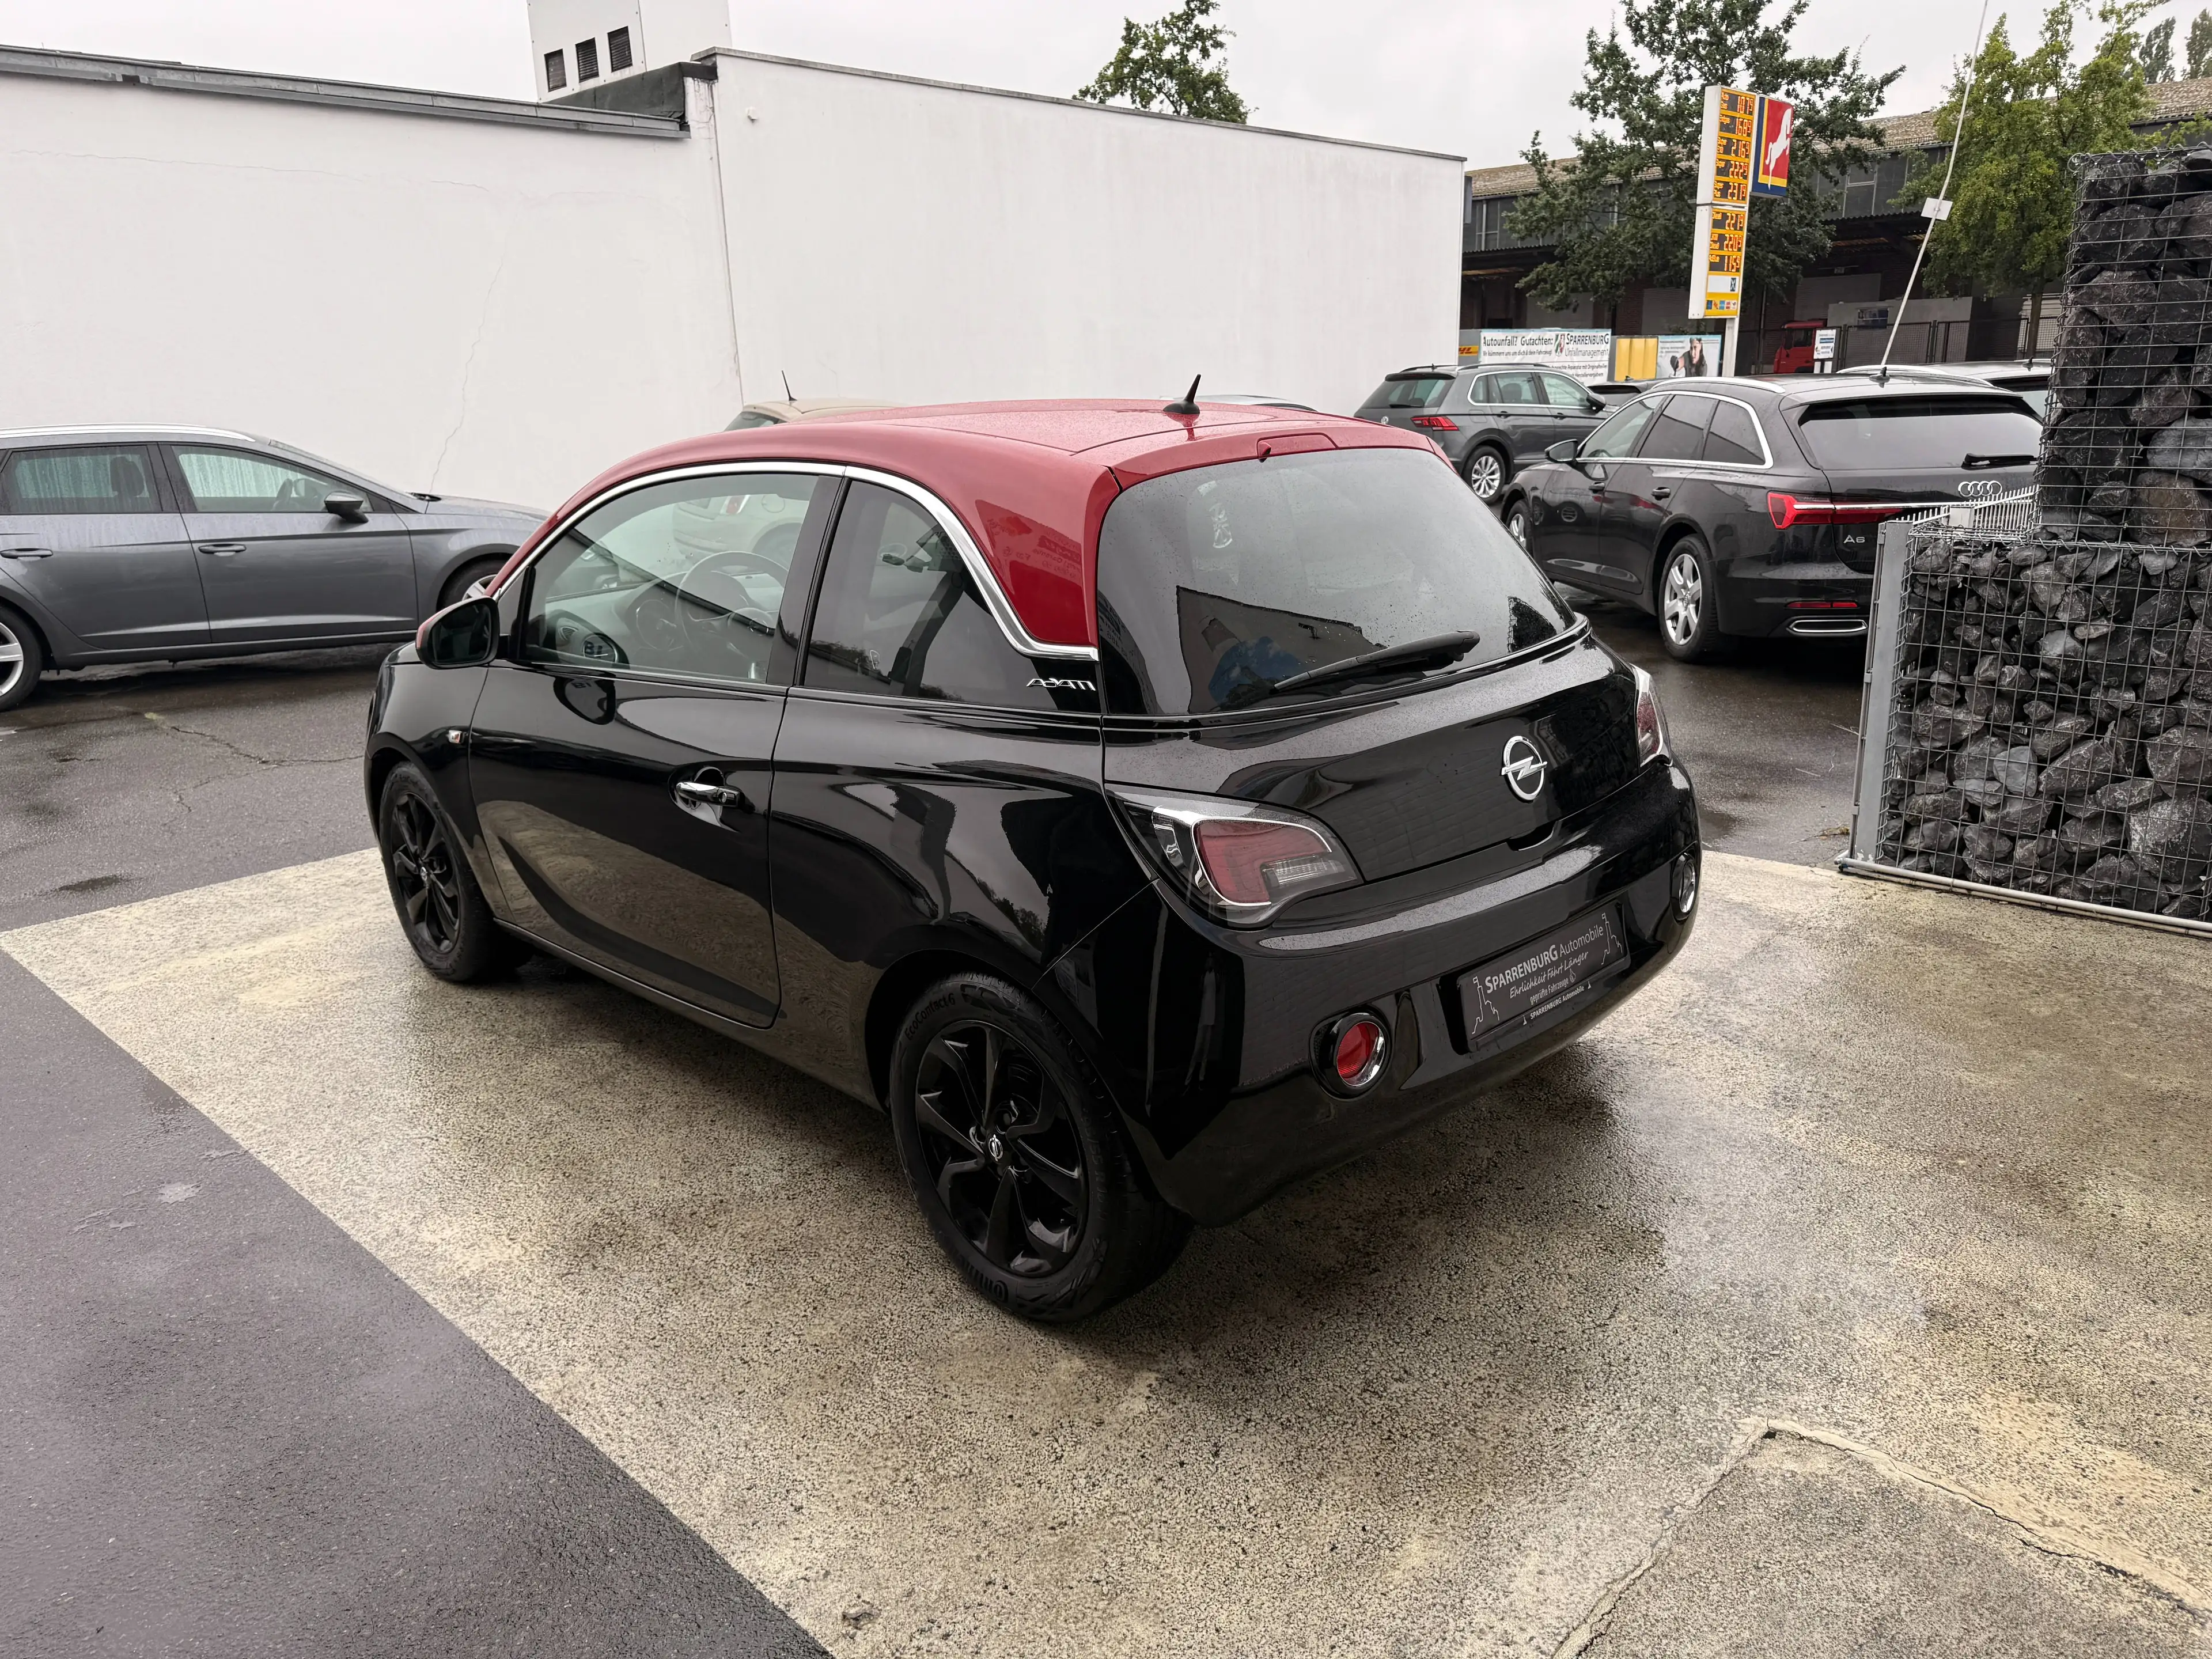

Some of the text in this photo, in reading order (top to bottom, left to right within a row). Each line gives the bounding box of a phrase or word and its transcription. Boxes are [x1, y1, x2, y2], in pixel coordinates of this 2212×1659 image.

[1483, 335, 1554, 346] Autounfall? Gutachten:
[1566, 333, 1609, 345] SPARRENBURG
[1565, 348, 1609, 358] Unfallmanagement
[1843, 535, 1865, 543] A6
[1485, 924, 1604, 994] SPARRENBURG Automobile
[1510, 952, 1589, 999] Ehrlichkeit Fährt Länger
[1530, 978, 1569, 1005] geprüfte Fahrzeuge
[1530, 985, 1584, 1020] SPARRENBURG Automobile
